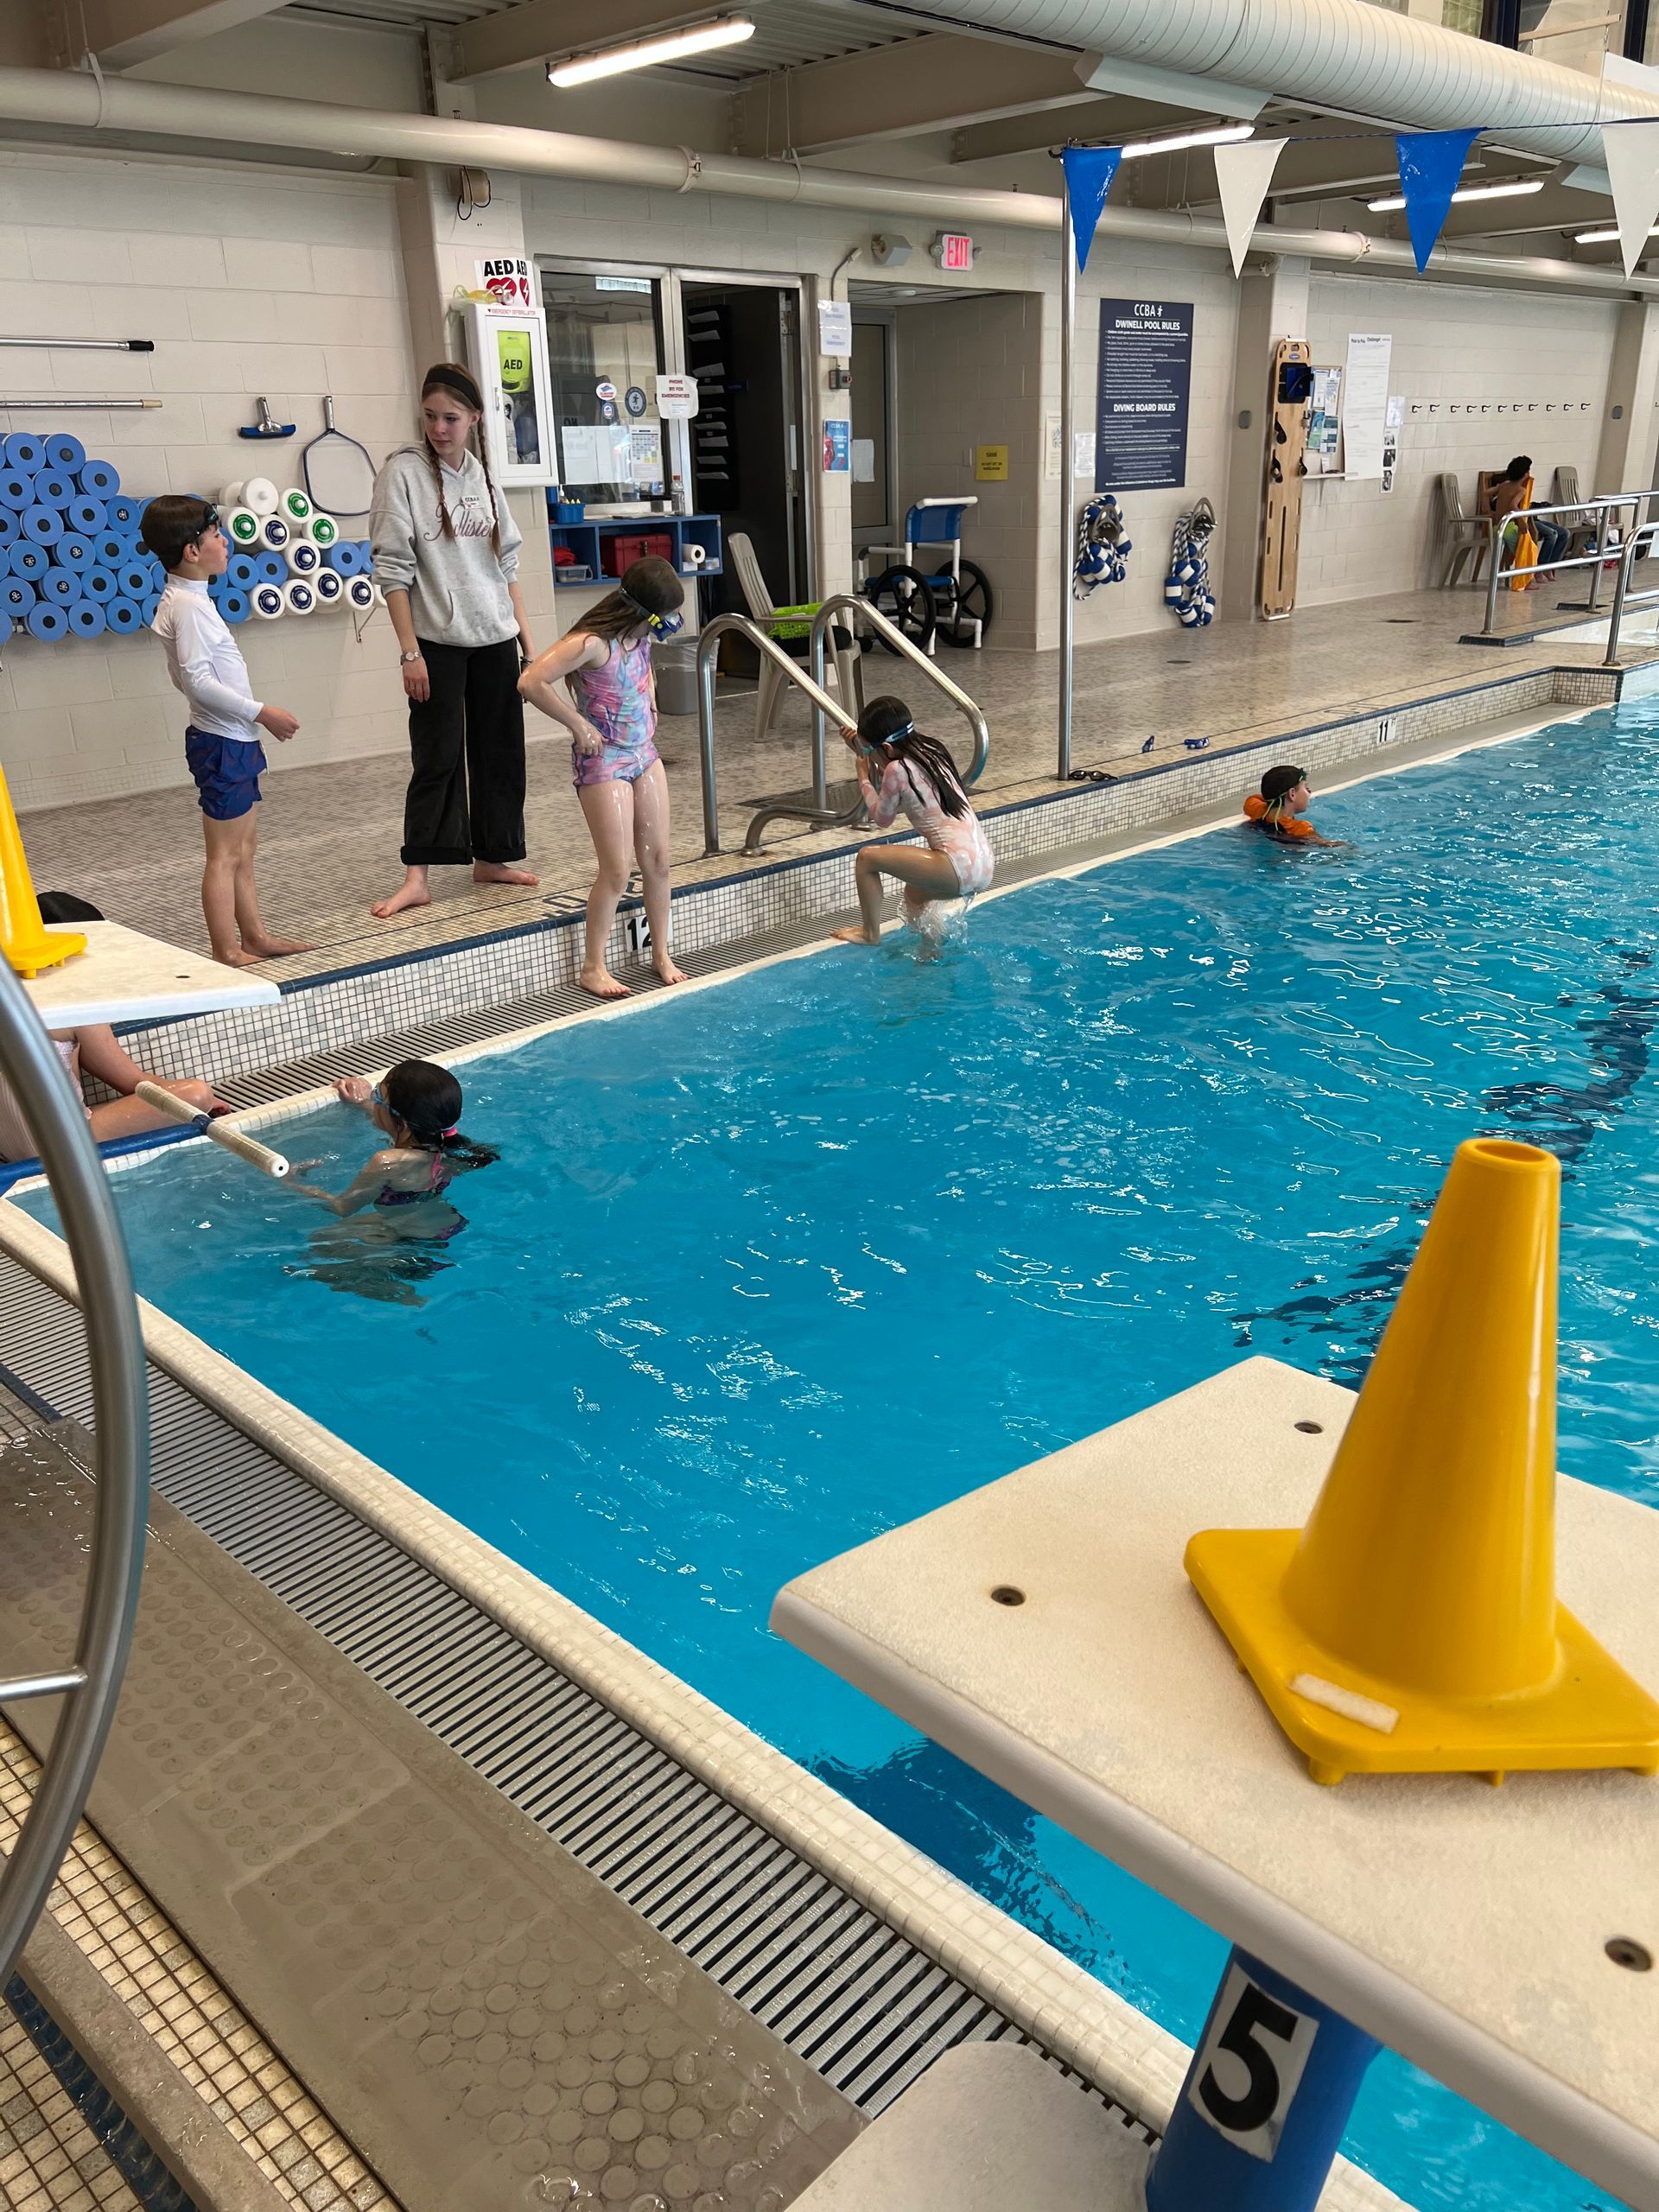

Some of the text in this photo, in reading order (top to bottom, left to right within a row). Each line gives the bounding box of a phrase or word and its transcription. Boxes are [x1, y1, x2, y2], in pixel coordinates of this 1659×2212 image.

[946, 237, 969, 268] EXIT
[484, 259, 514, 276] AED
[516, 259, 528, 276] AED
[1134, 303, 1156, 317] CCBA
[1115, 319, 1180, 330] DWINELL POOL RULES
[503, 359, 523, 370] AED
[1113, 404, 1135, 412] DIVING
[1135, 404, 1157, 412] BOARD
[1198, 1982, 1299, 2132] 5
